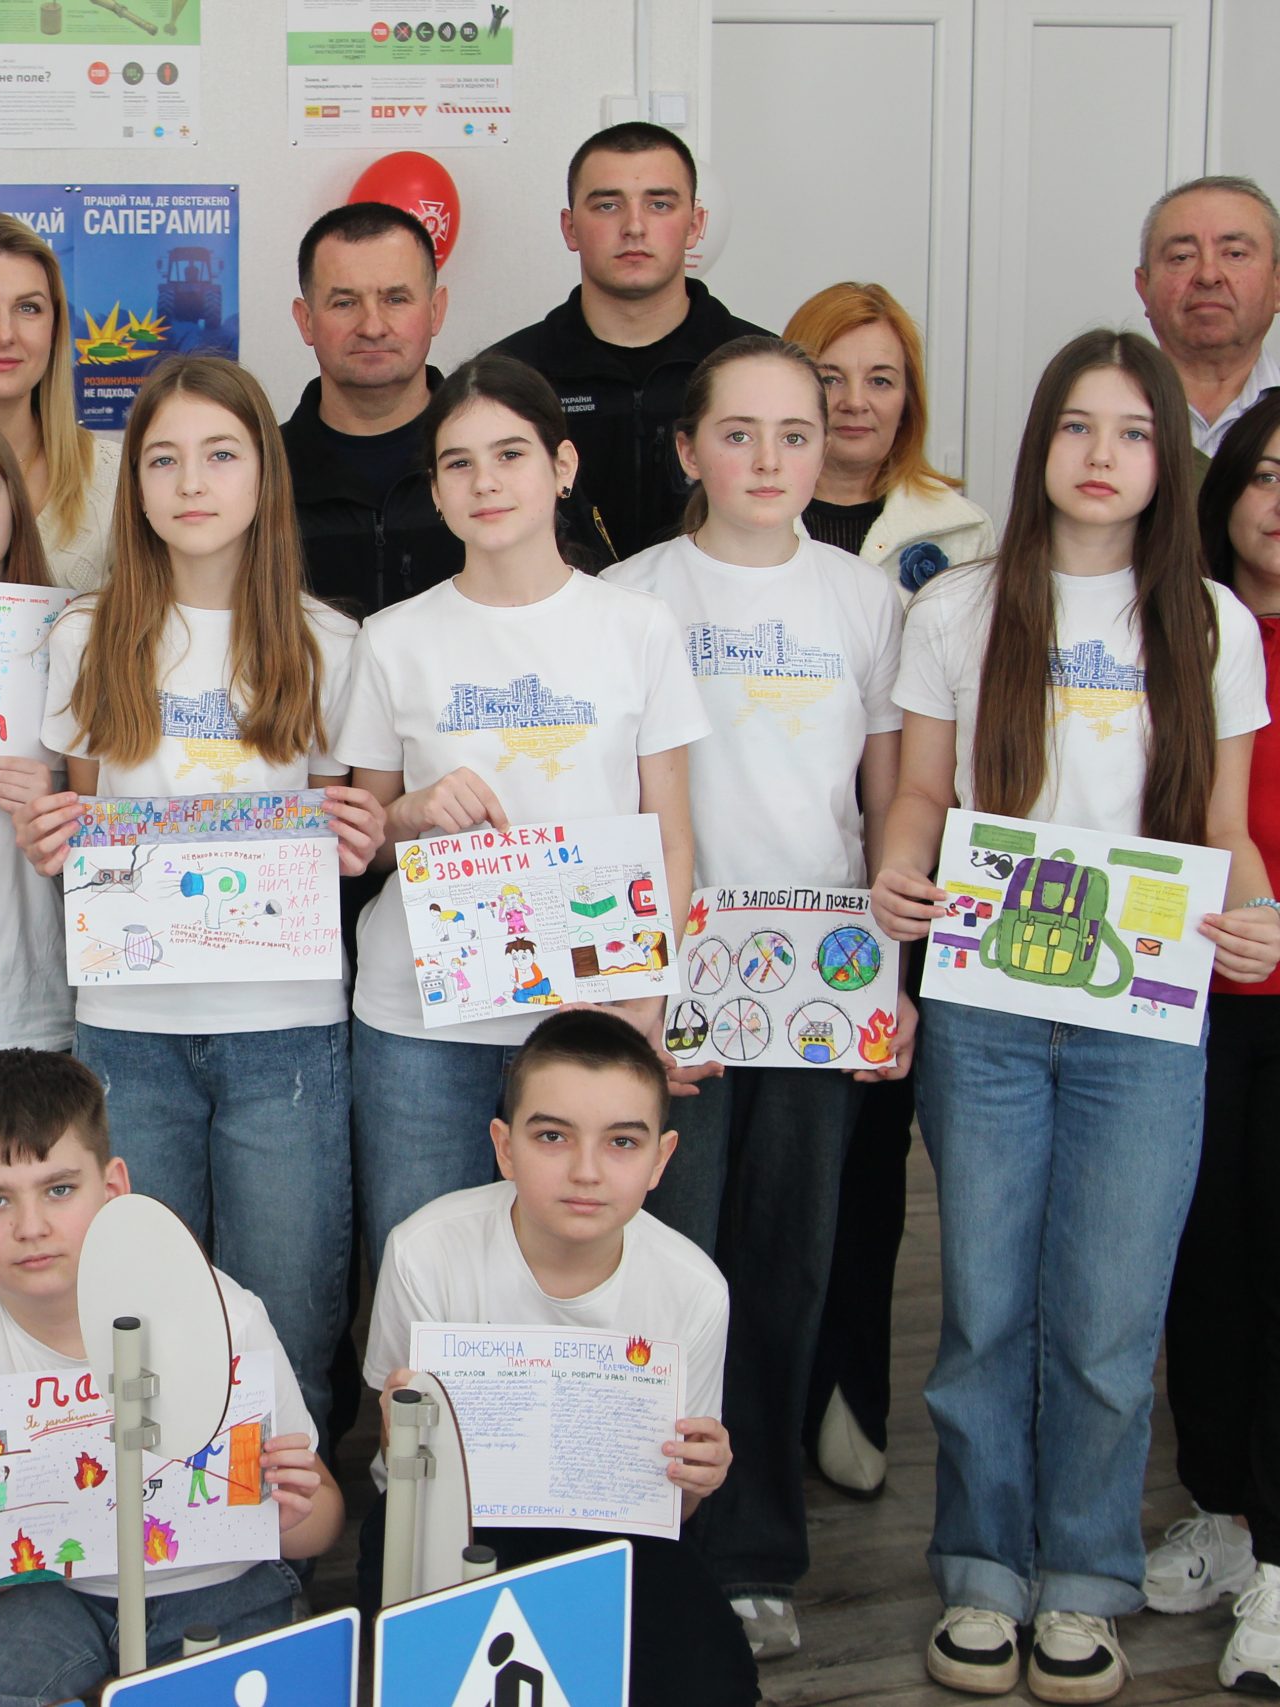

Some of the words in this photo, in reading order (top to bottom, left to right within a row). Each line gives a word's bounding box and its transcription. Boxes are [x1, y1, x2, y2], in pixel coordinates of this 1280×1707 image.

[16, 72, 51, 83] поле?
[84, 194, 127, 208] ПРАЦЮЙ
[129, 196, 154, 208] ТАМ,
[156, 196, 169, 208] ДЕ
[172, 196, 230, 207] ОБСТЕЖЕНО
[84, 209, 231, 235] САПЕРАМИ!
[84, 388, 96, 397] НЕ
[561, 396, 592, 404] УКРАЇНИ
[568, 404, 595, 413] RESCUER
[701, 628, 712, 660] Lviv
[726, 645, 764, 661] Kyiv
[1050, 662, 1081, 675] Kyiv
[1092, 644, 1102, 680] Donetsk
[464, 689, 473, 716] Lviv
[486, 701, 520, 716] Kyiv
[174, 711, 206, 725] Kyiv
[217, 692, 226, 730] Donetsk
[203, 732, 243, 742] Khark
[80, 801, 154, 815] РАВИЛА
[258, 795, 299, 808] ПРИ
[83, 811, 201, 826] ОРИСТУВАННІ
[153, 822, 180, 834] ТА
[69, 834, 137, 848] НАННЯ
[429, 840, 461, 856] ПРИ
[470, 826, 566, 850] ПОЖЕЖІ
[279, 843, 321, 859] БУДЬ
[434, 853, 530, 881] ЗВОНИТИ
[544, 845, 583, 867] 101
[297, 876, 317, 890] НЕ
[717, 889, 737, 909] ЯК
[743, 886, 821, 909] ЗАПОБІГТИ
[826, 895, 870, 911] ПОЖЕЖІ
[279, 912, 305, 928] ТУЙ
[292, 944, 333, 957] КОЮ!
[554, 1341, 614, 1361] БЕЗПЕКА
[651, 1363, 672, 1377] 101!
[472, 1505, 508, 1515] УДЬТЕ
[512, 1505, 564, 1516] ОБЕРЕЖНІ
